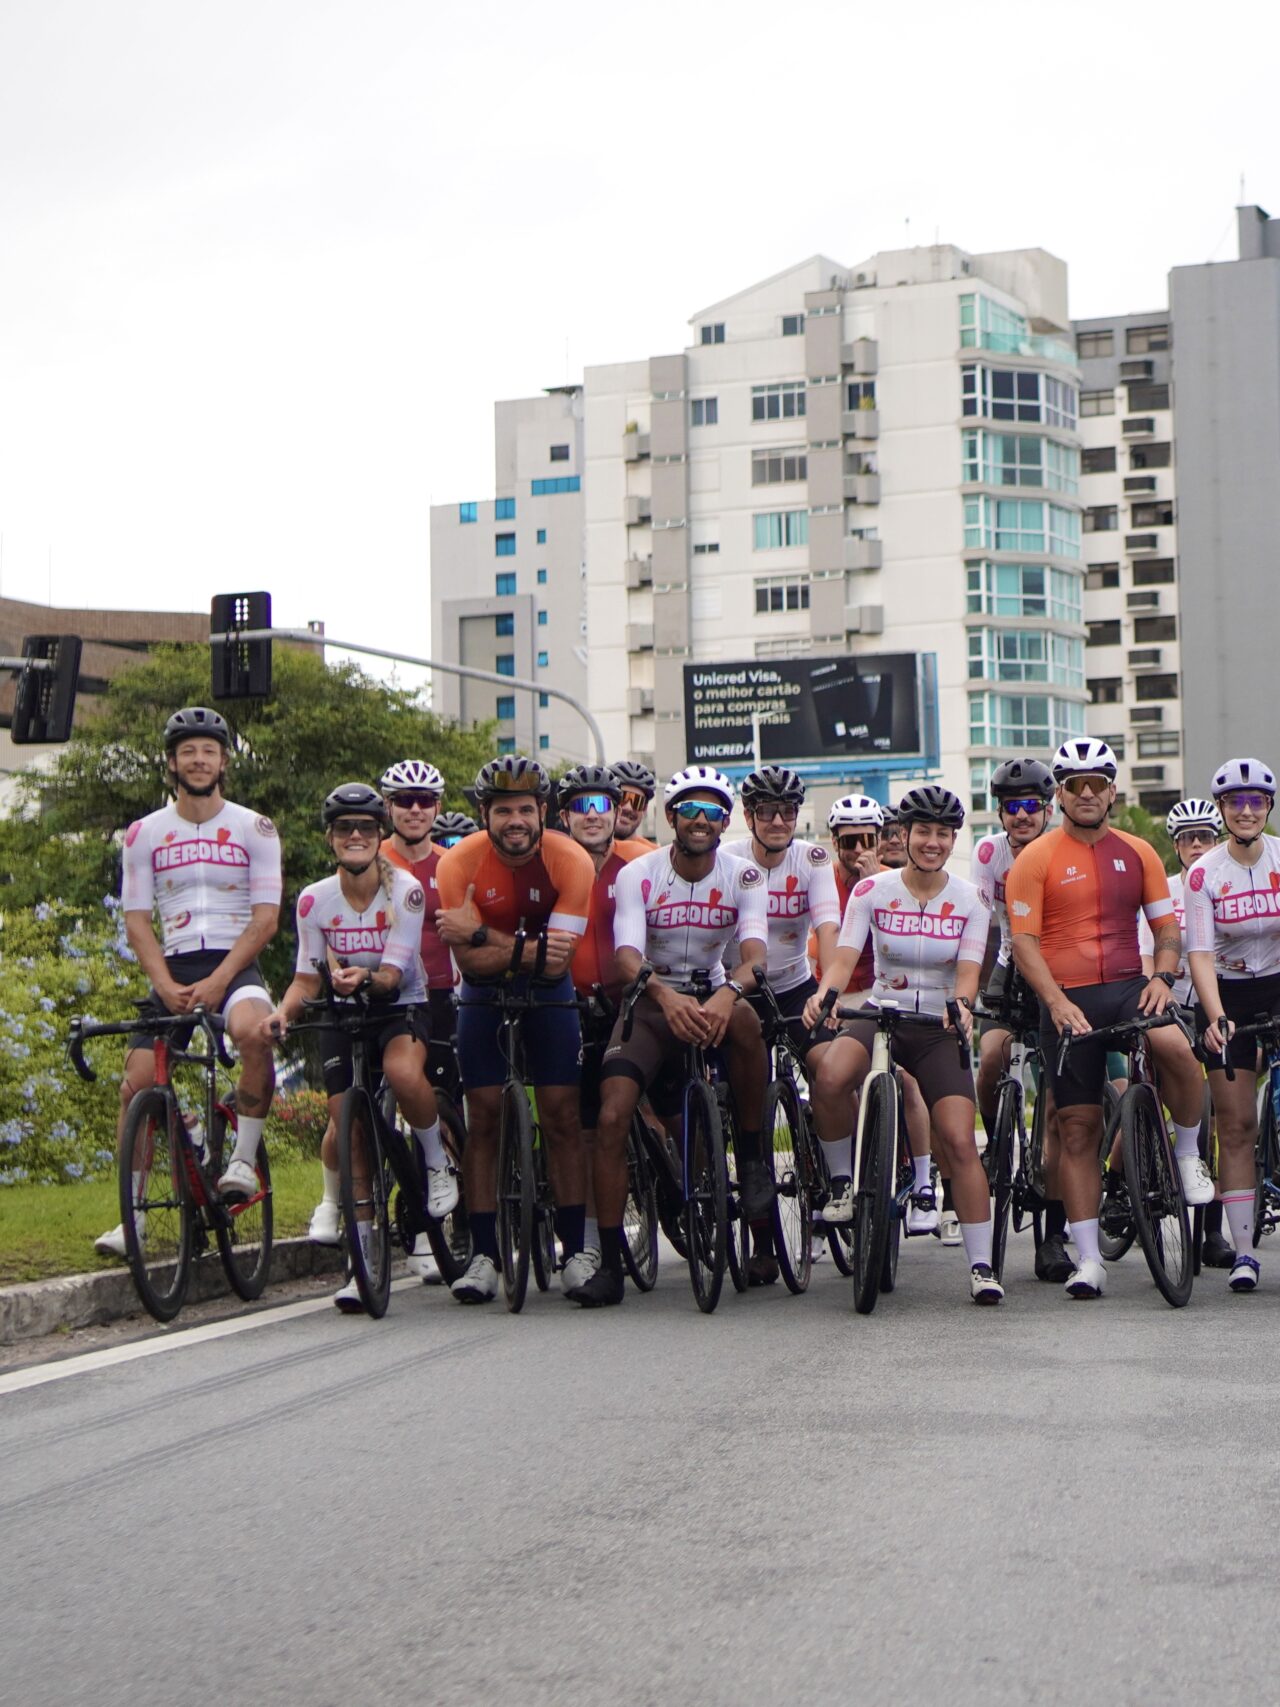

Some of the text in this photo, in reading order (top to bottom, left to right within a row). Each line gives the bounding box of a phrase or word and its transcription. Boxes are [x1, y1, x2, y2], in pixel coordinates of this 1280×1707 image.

[693, 669, 782, 687] Unicred Visa,
[693, 690, 703, 701] o
[705, 686, 754, 700] melhor
[757, 681, 801, 697] cartão
[694, 699, 787, 715] para compras
[694, 713, 791, 729] internacnais
[694, 743, 745, 758] UNICRED
[155, 841, 249, 869] HEROICA
[878, 911, 965, 937] HEROICA
